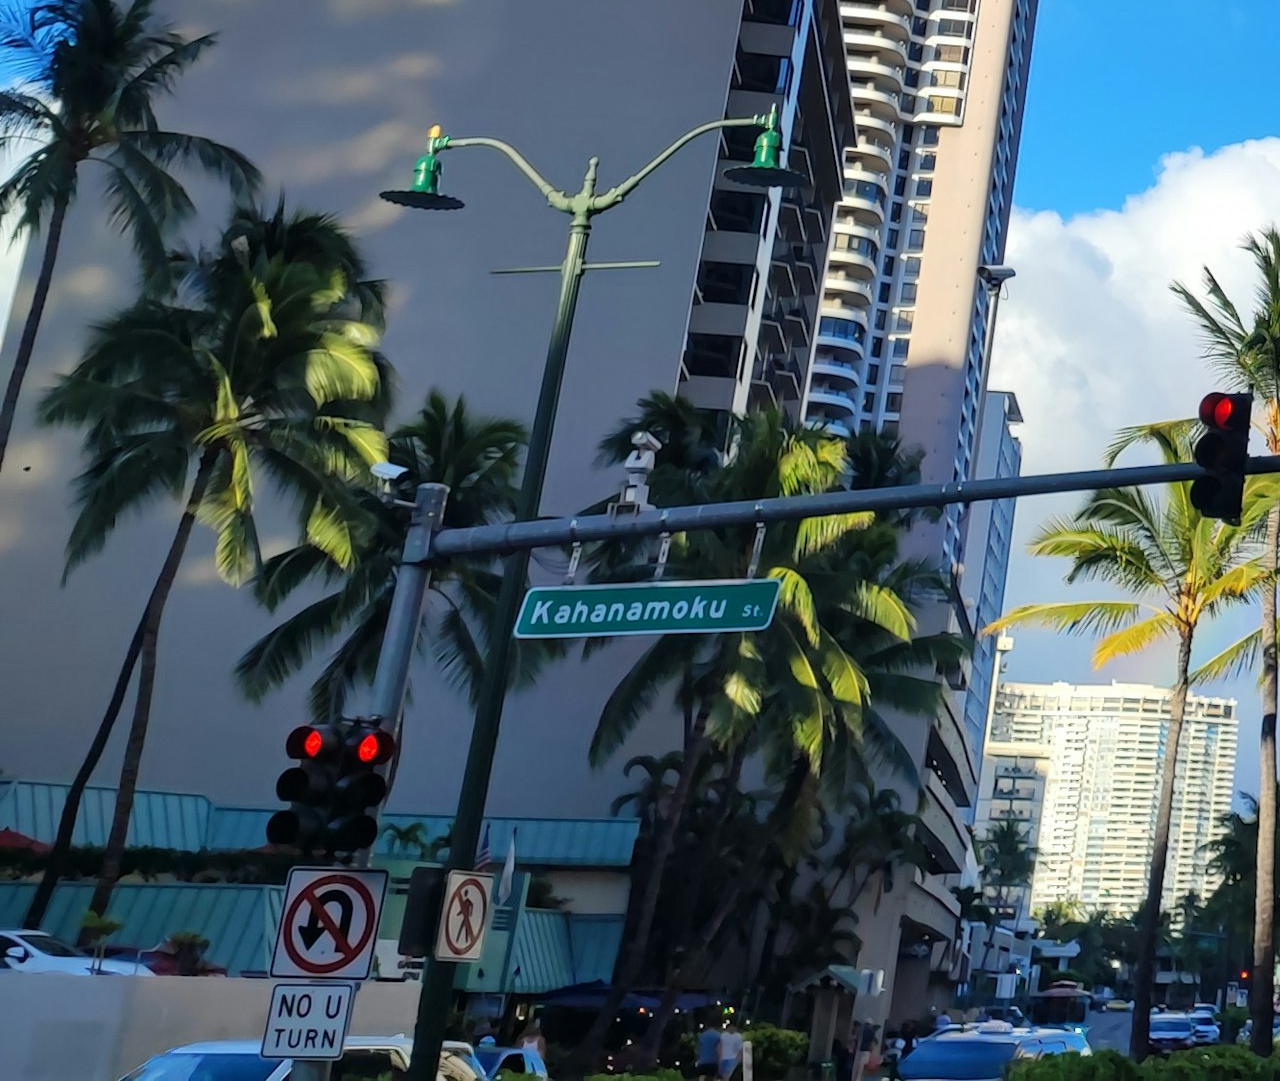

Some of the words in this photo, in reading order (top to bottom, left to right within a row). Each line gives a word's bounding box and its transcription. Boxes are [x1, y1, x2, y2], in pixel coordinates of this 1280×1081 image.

[530, 596, 728, 625] Kahanamoku
[278, 993, 312, 1018] NO
[325, 995, 342, 1019] U
[274, 1028, 337, 1049] TURN
